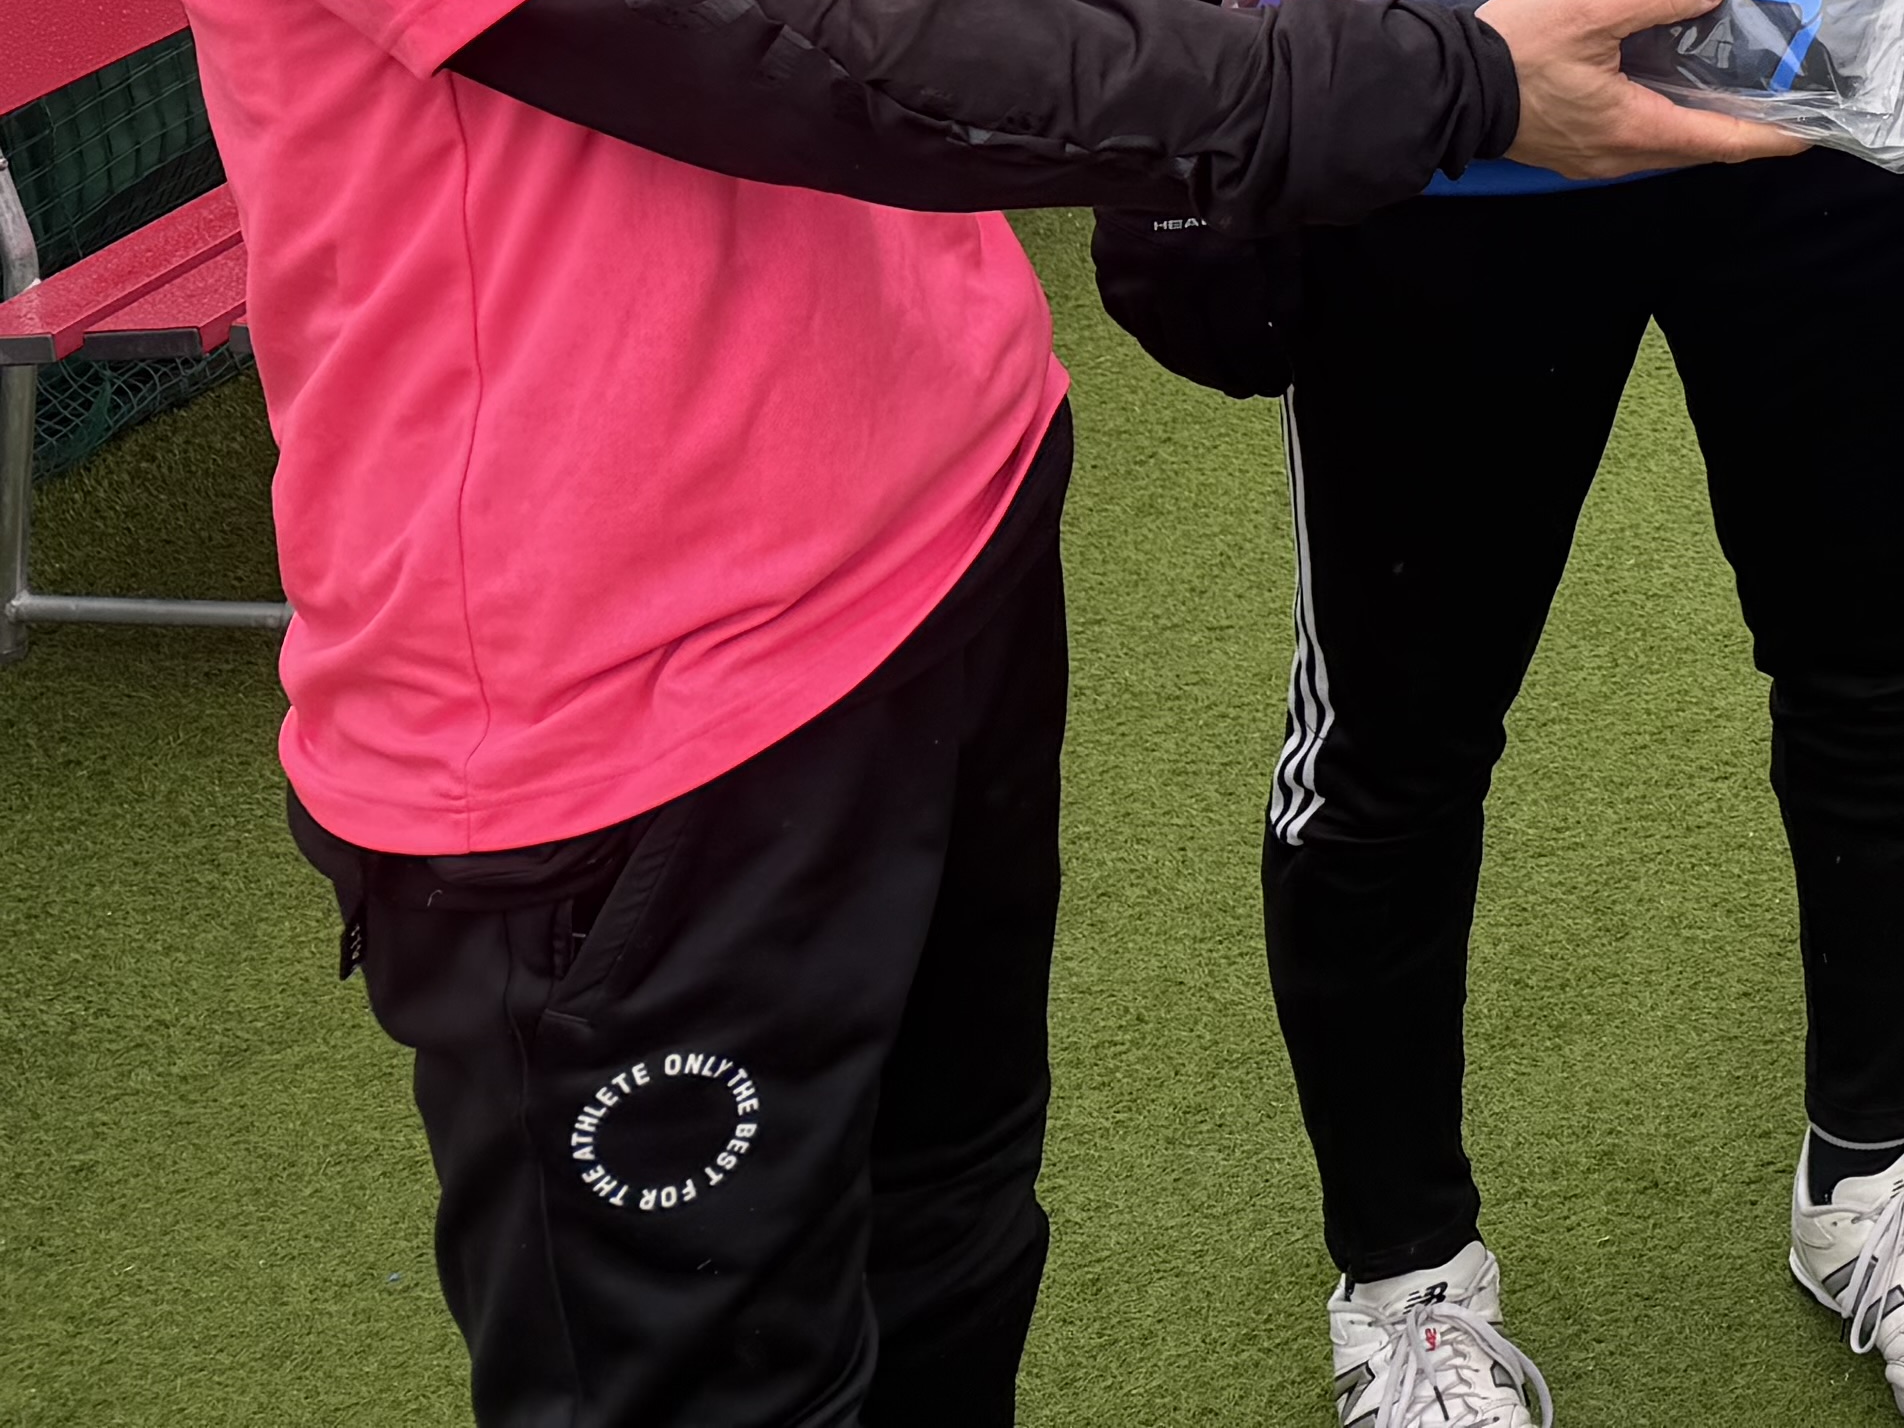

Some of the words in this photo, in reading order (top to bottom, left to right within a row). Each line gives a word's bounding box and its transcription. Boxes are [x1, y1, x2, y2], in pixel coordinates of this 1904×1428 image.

[664, 1053, 733, 1078] ONLY
[571, 1062, 650, 1161] ATHLETE
[727, 1068, 759, 1116] THE
[704, 1123, 758, 1186] BEST
[581, 1164, 629, 1206] THE
[639, 1178, 697, 1211] FOR
